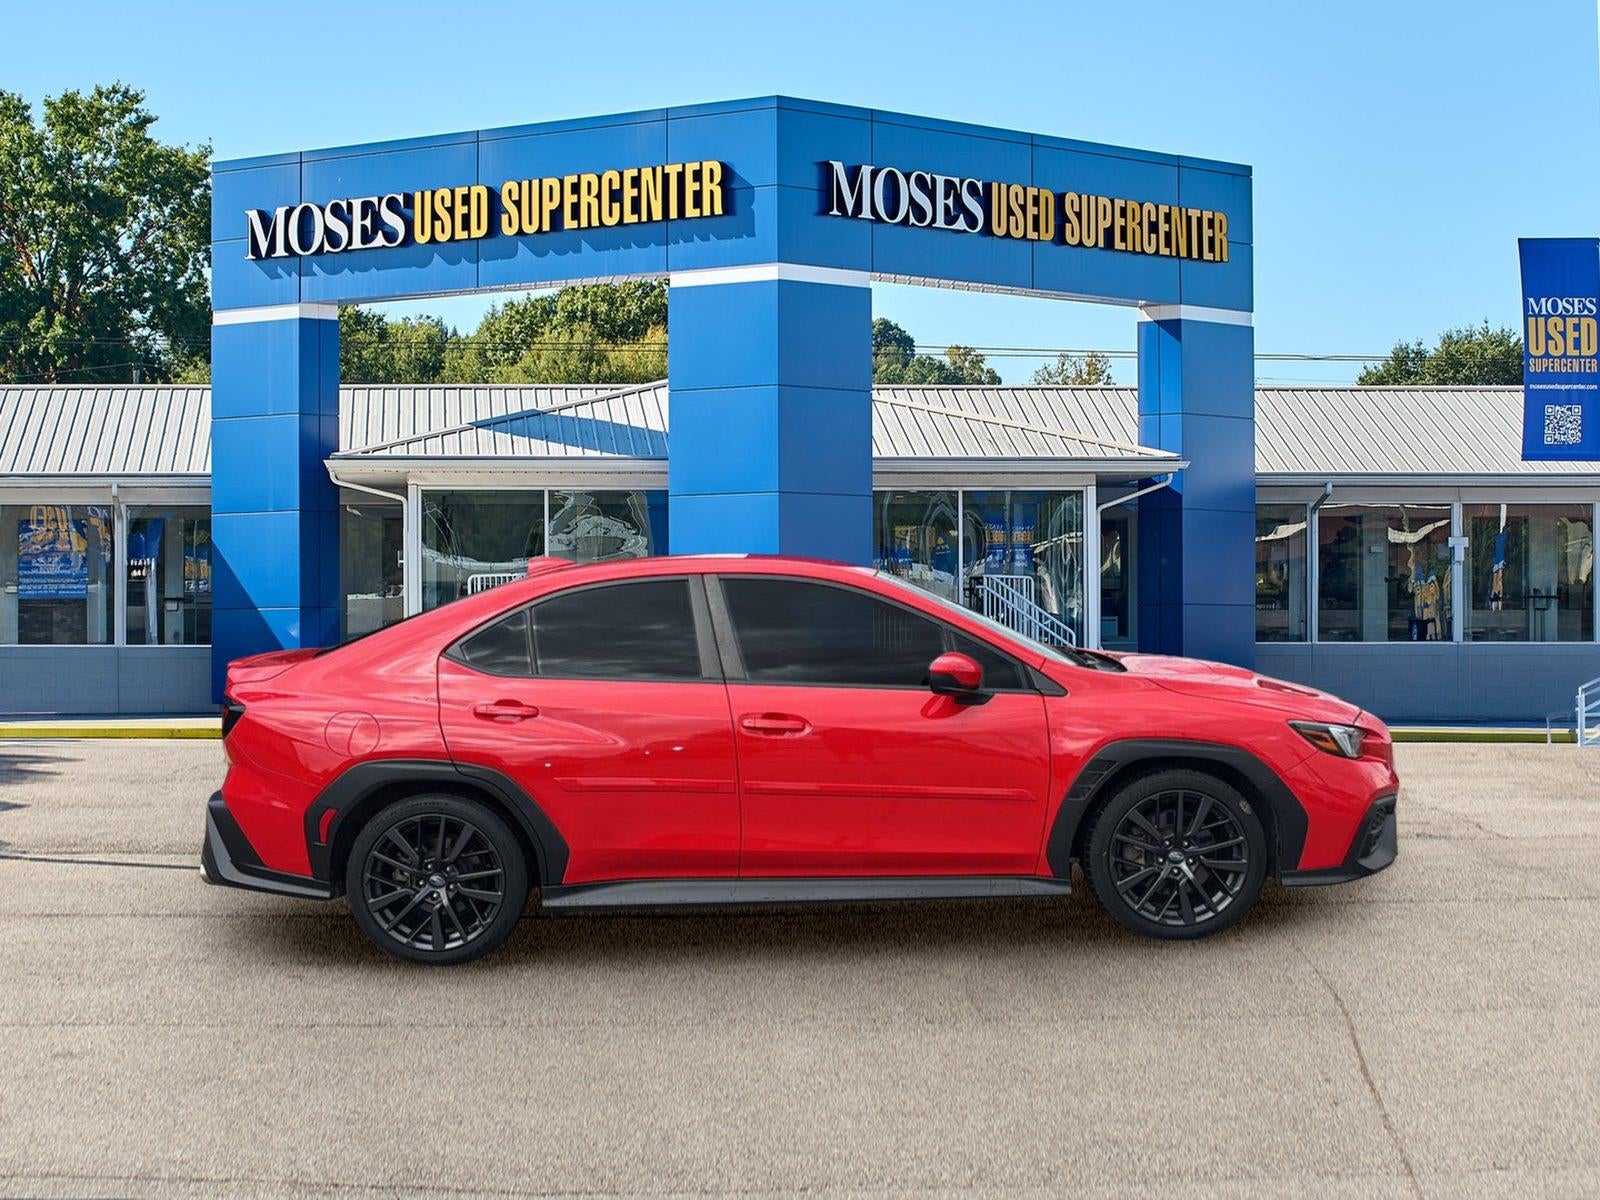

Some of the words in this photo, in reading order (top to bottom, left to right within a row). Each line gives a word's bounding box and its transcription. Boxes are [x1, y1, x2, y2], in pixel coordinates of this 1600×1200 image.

[245, 193, 406, 260] MOSES
[412, 184, 488, 245] USED
[500, 160, 723, 237] SUPERCENTER
[828, 160, 984, 233] MOSES
[990, 181, 1055, 242] USED
[1064, 190, 1229, 263] SUPERCENTER
[1527, 297, 1597, 315] MOSES
[1528, 316, 1598, 356] USED
[1529, 358, 1598, 373] SUPERCENTER
